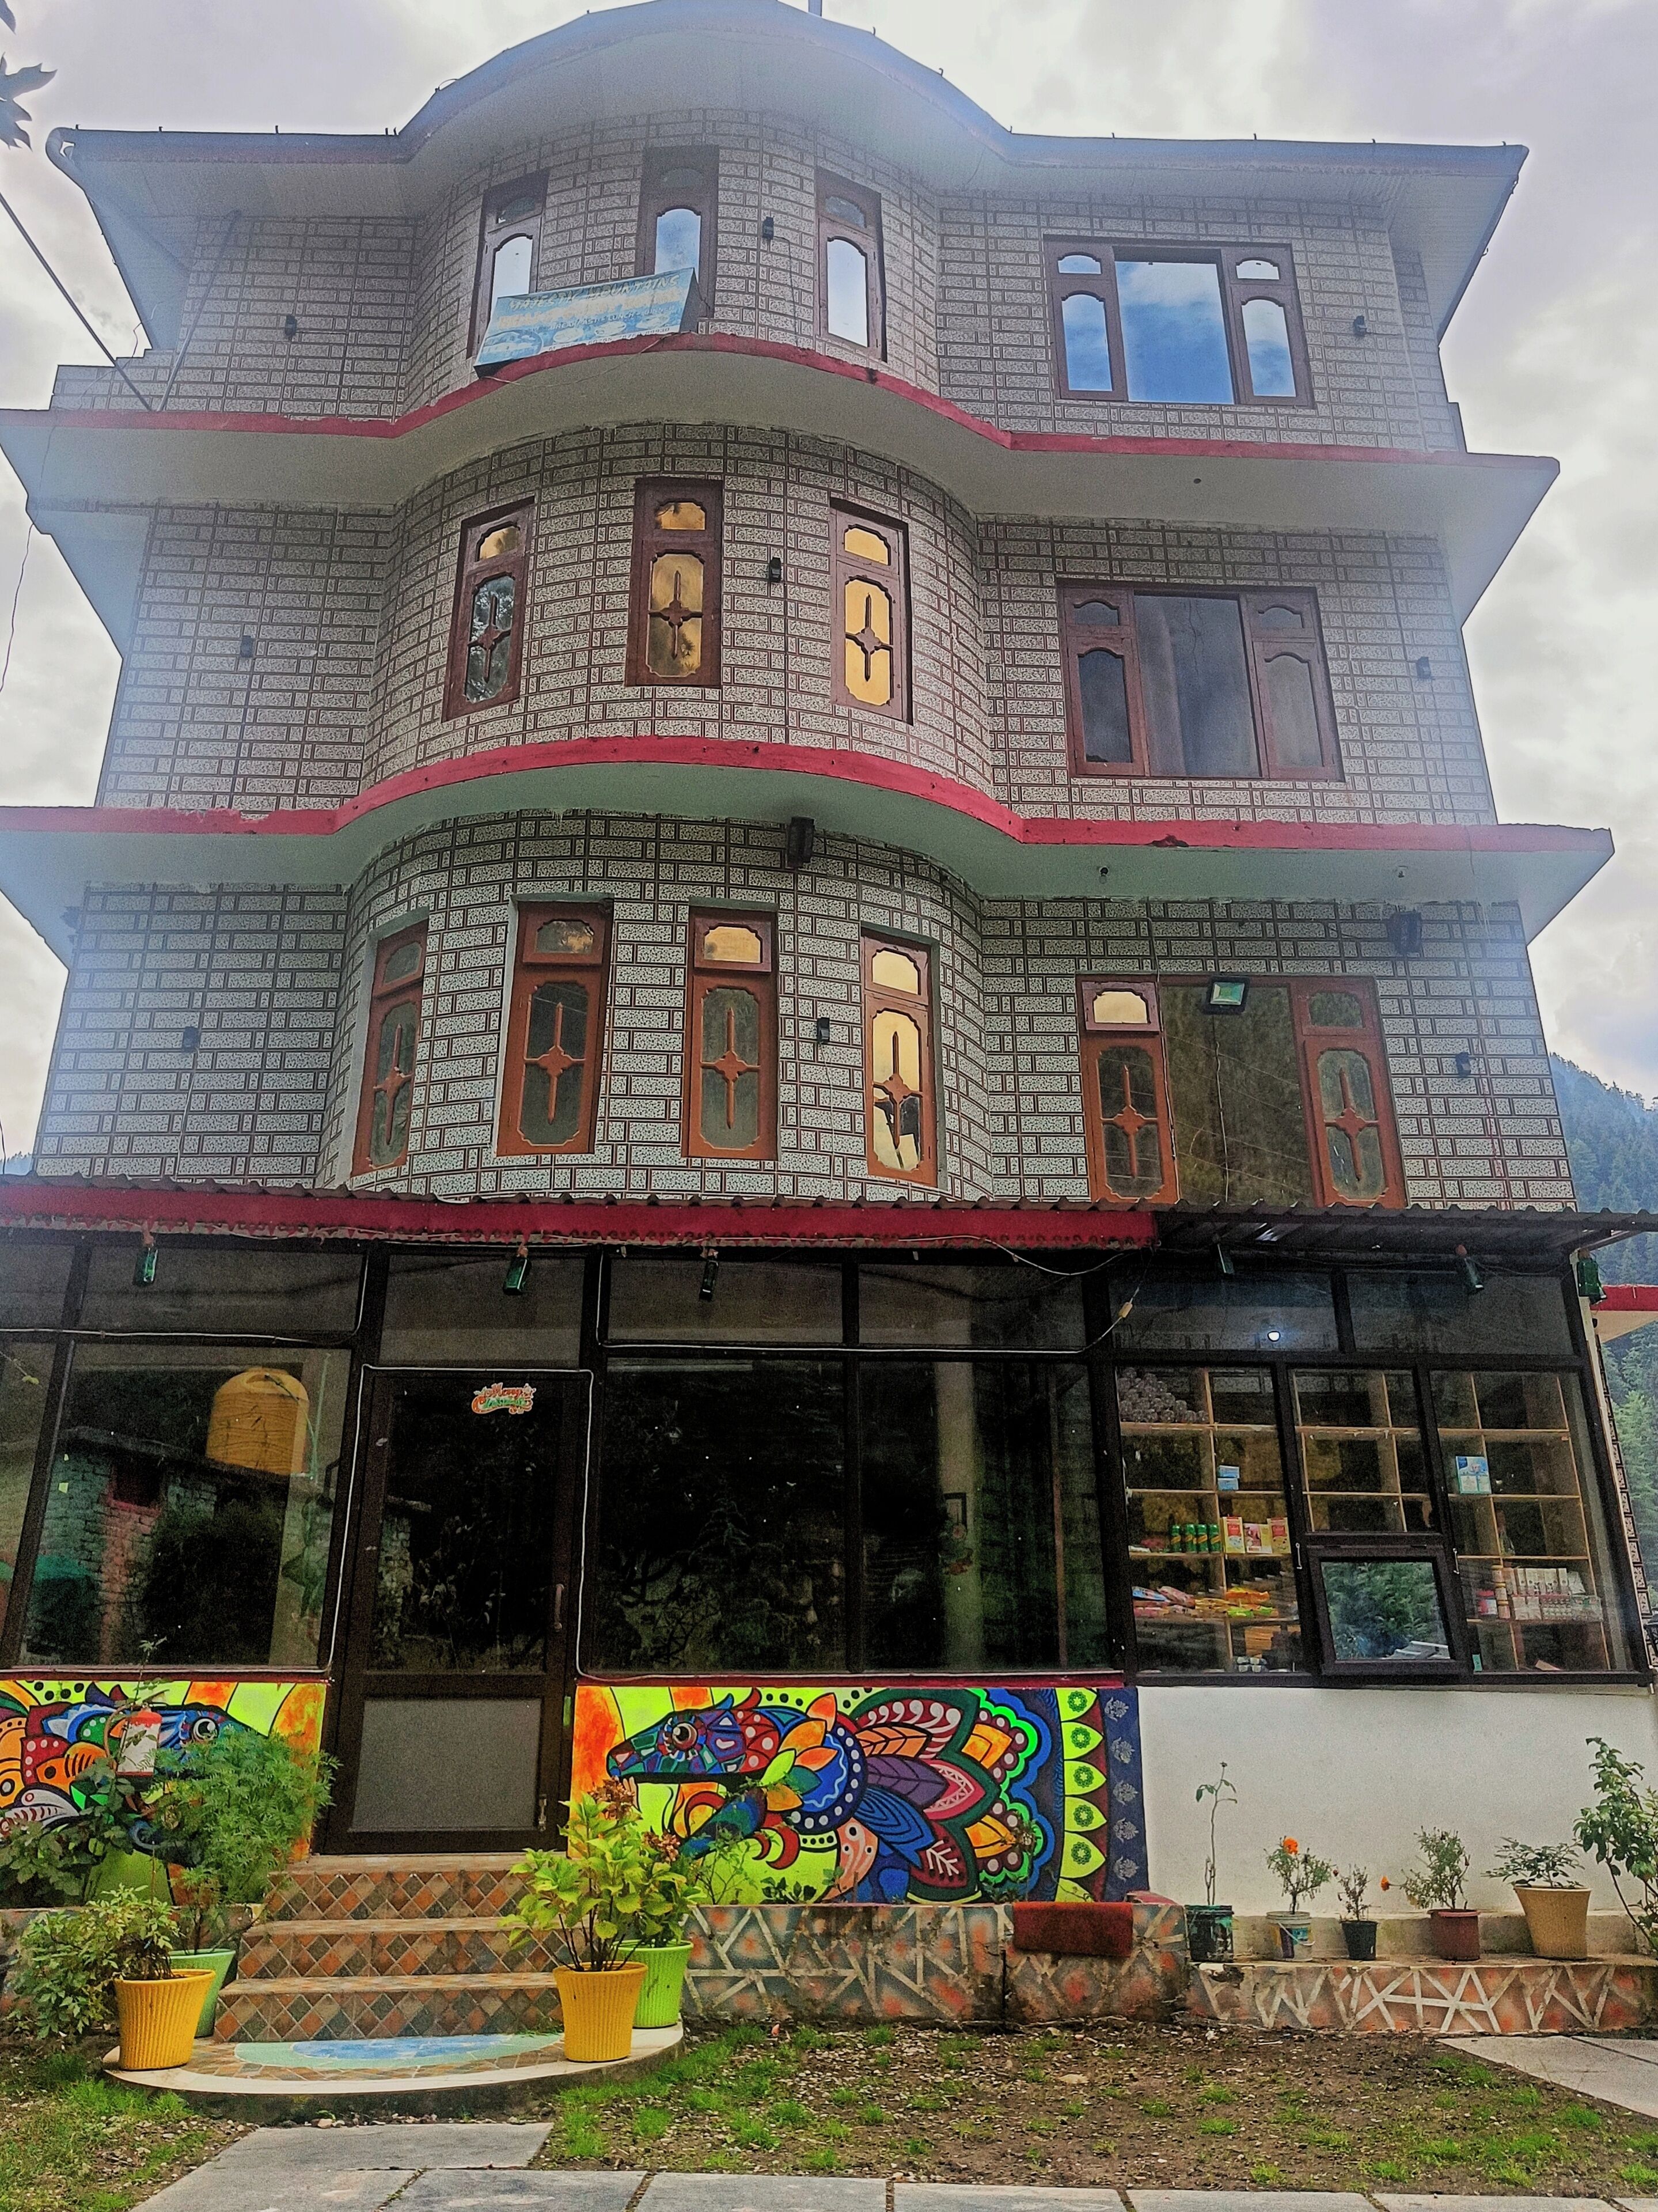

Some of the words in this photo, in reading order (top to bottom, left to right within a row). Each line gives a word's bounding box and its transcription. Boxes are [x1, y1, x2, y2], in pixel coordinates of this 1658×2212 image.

[509, 290, 581, 310] MAJESTIC
[587, 274, 680, 300] MOUNTAINS
[608, 312, 634, 321] LUNCH
